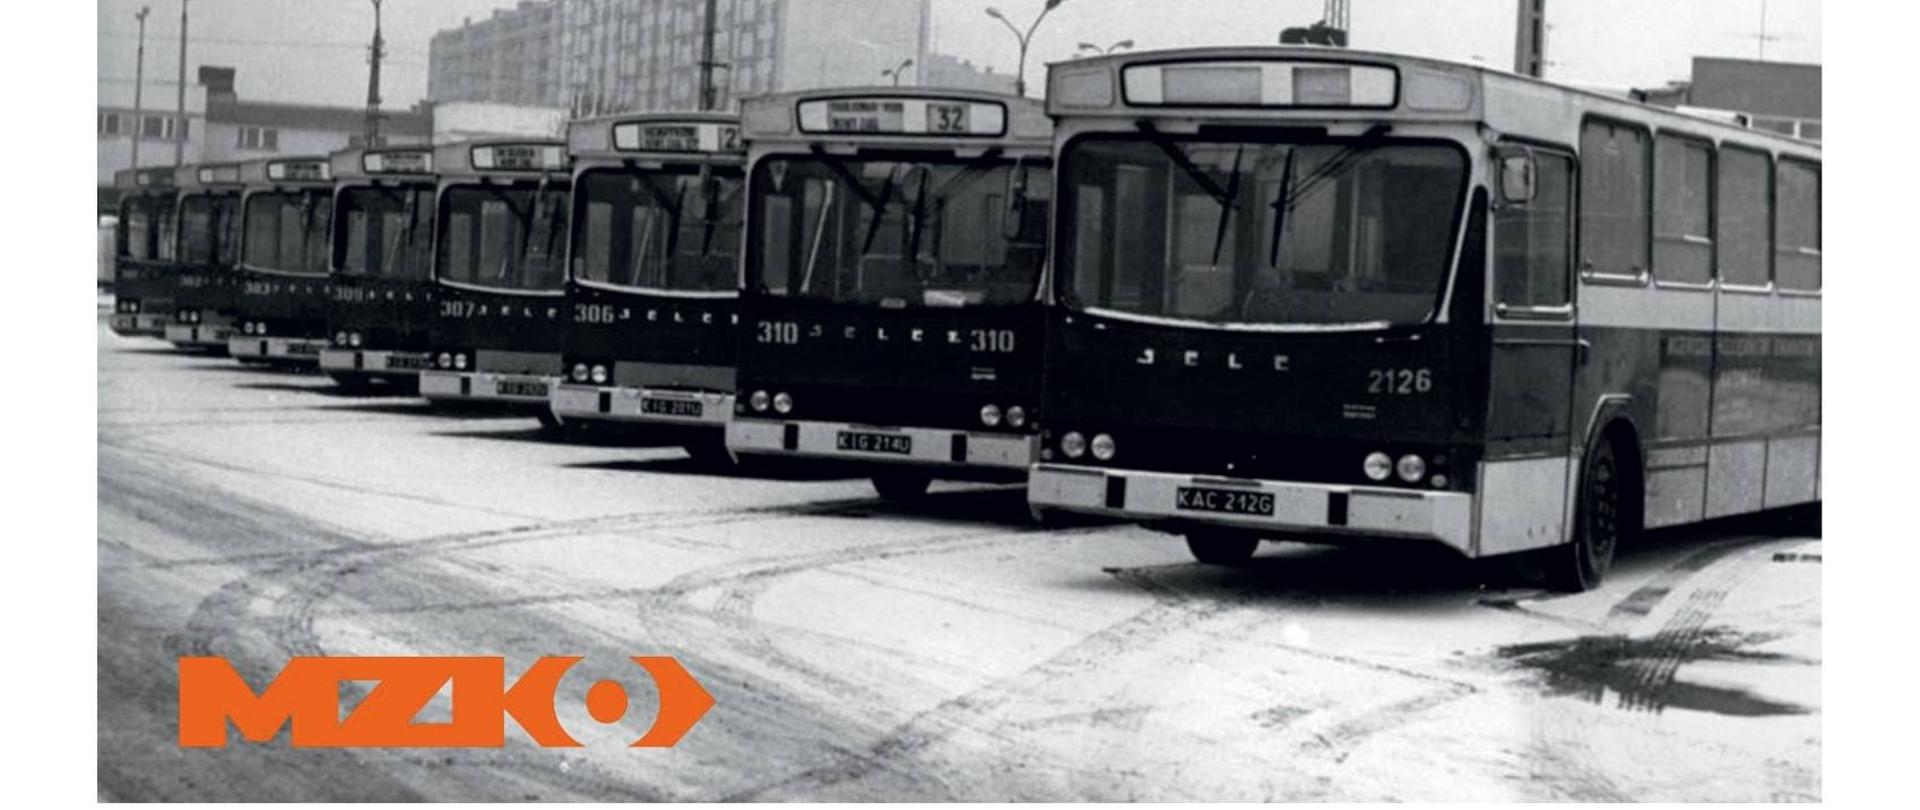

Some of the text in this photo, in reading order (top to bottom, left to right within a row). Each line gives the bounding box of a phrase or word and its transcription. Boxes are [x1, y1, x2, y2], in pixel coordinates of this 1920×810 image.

[937, 106, 964, 131] 32
[440, 300, 475, 319] 307
[574, 303, 614, 323] 306
[757, 321, 798, 345] 310
[970, 328, 1015, 352] 310
[1367, 368, 1432, 394] 2126
[641, 398, 667, 413] KIG
[838, 433, 911, 454] KIG 214U
[1177, 490, 1272, 513] KAC 212G
